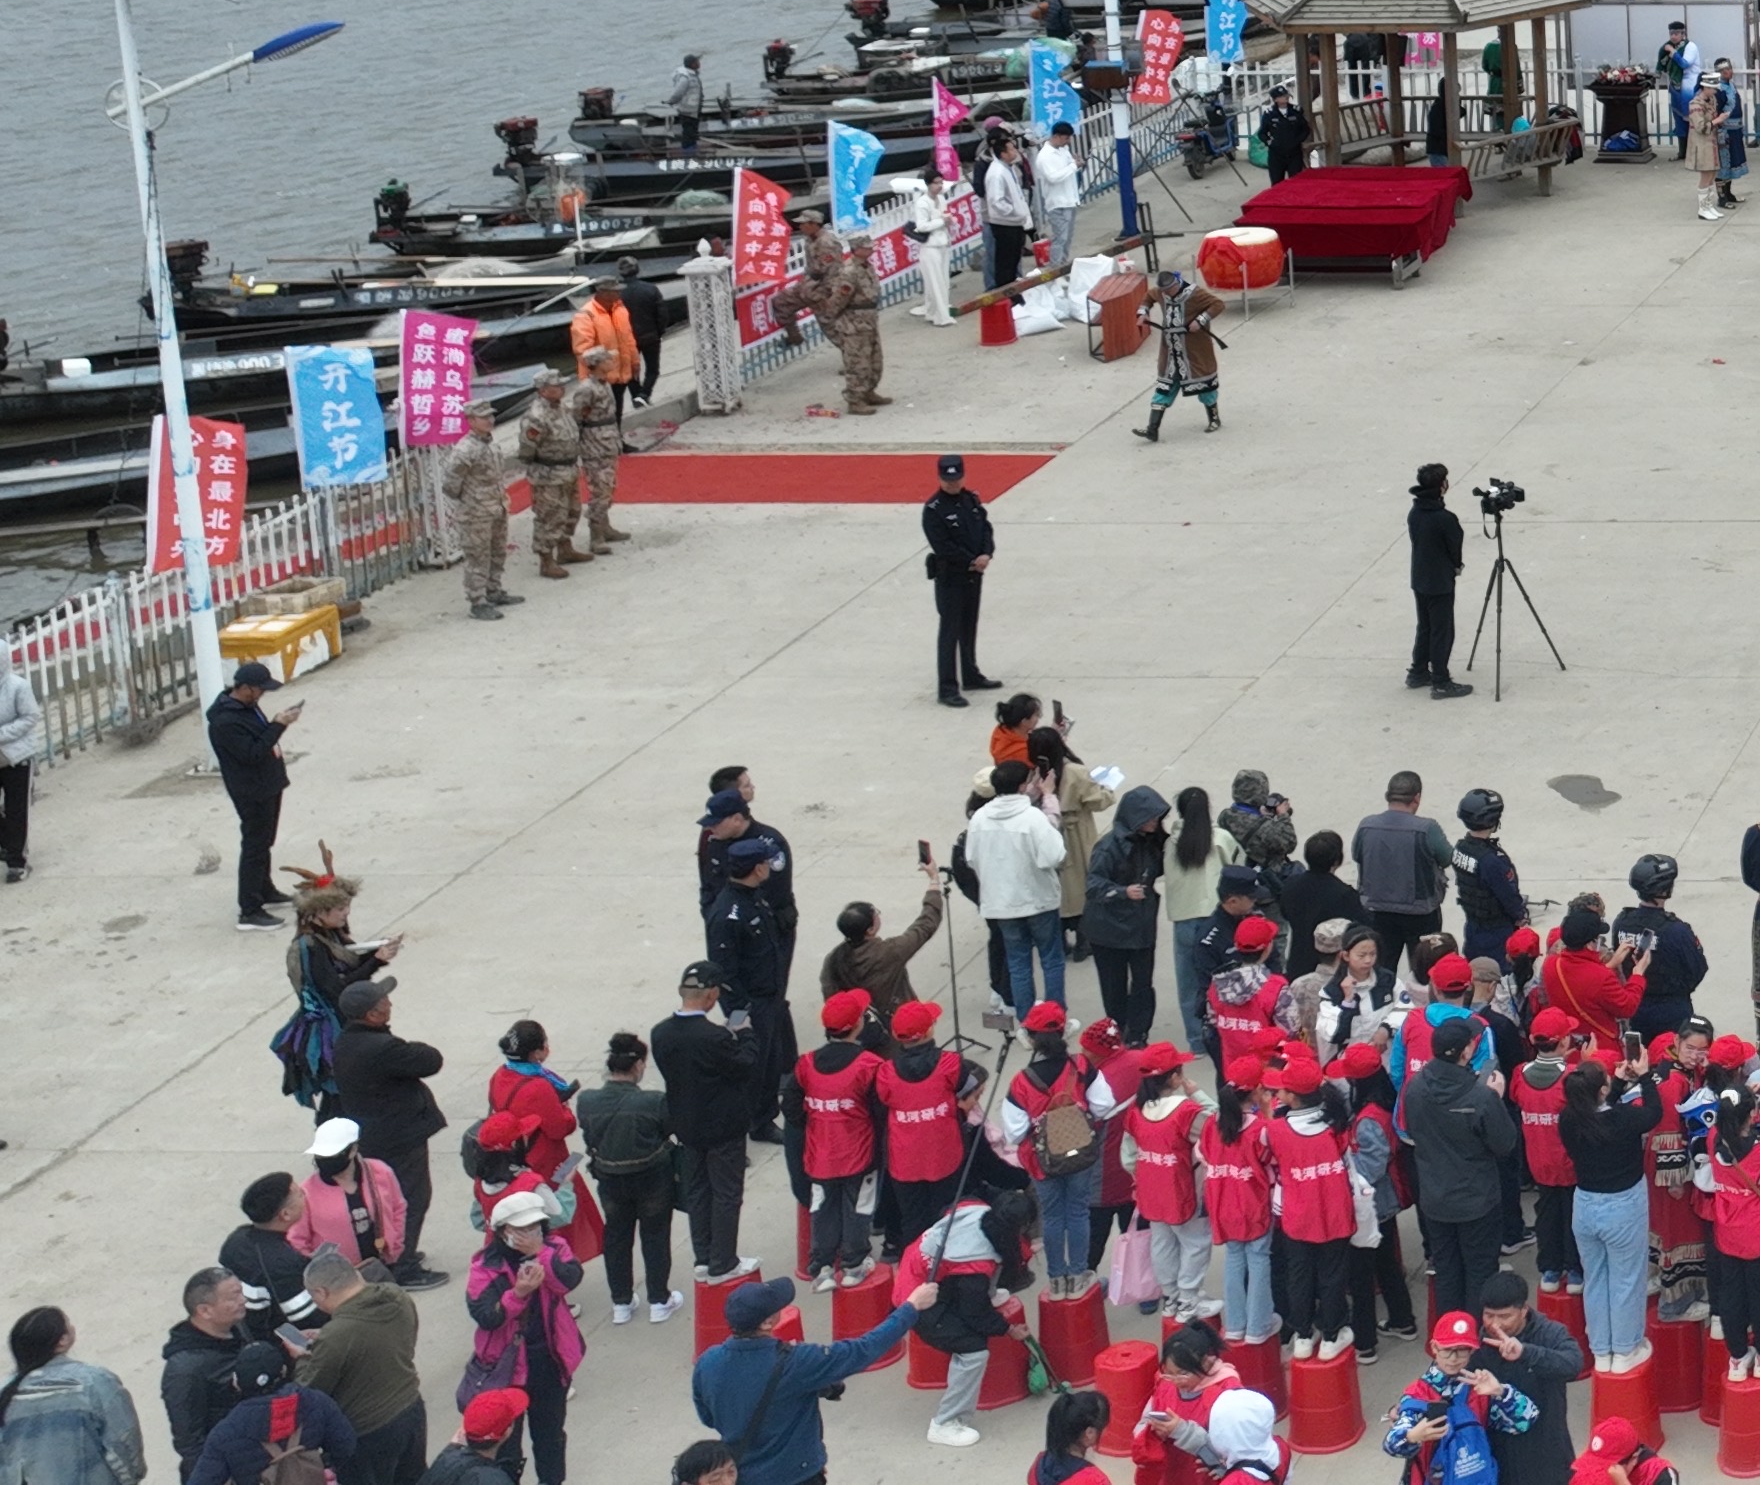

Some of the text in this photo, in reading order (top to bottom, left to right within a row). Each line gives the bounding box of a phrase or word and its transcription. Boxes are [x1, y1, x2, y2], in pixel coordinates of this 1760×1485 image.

[318, 362, 362, 469] 开江节
[204, 428, 238, 556] 身在最北方
